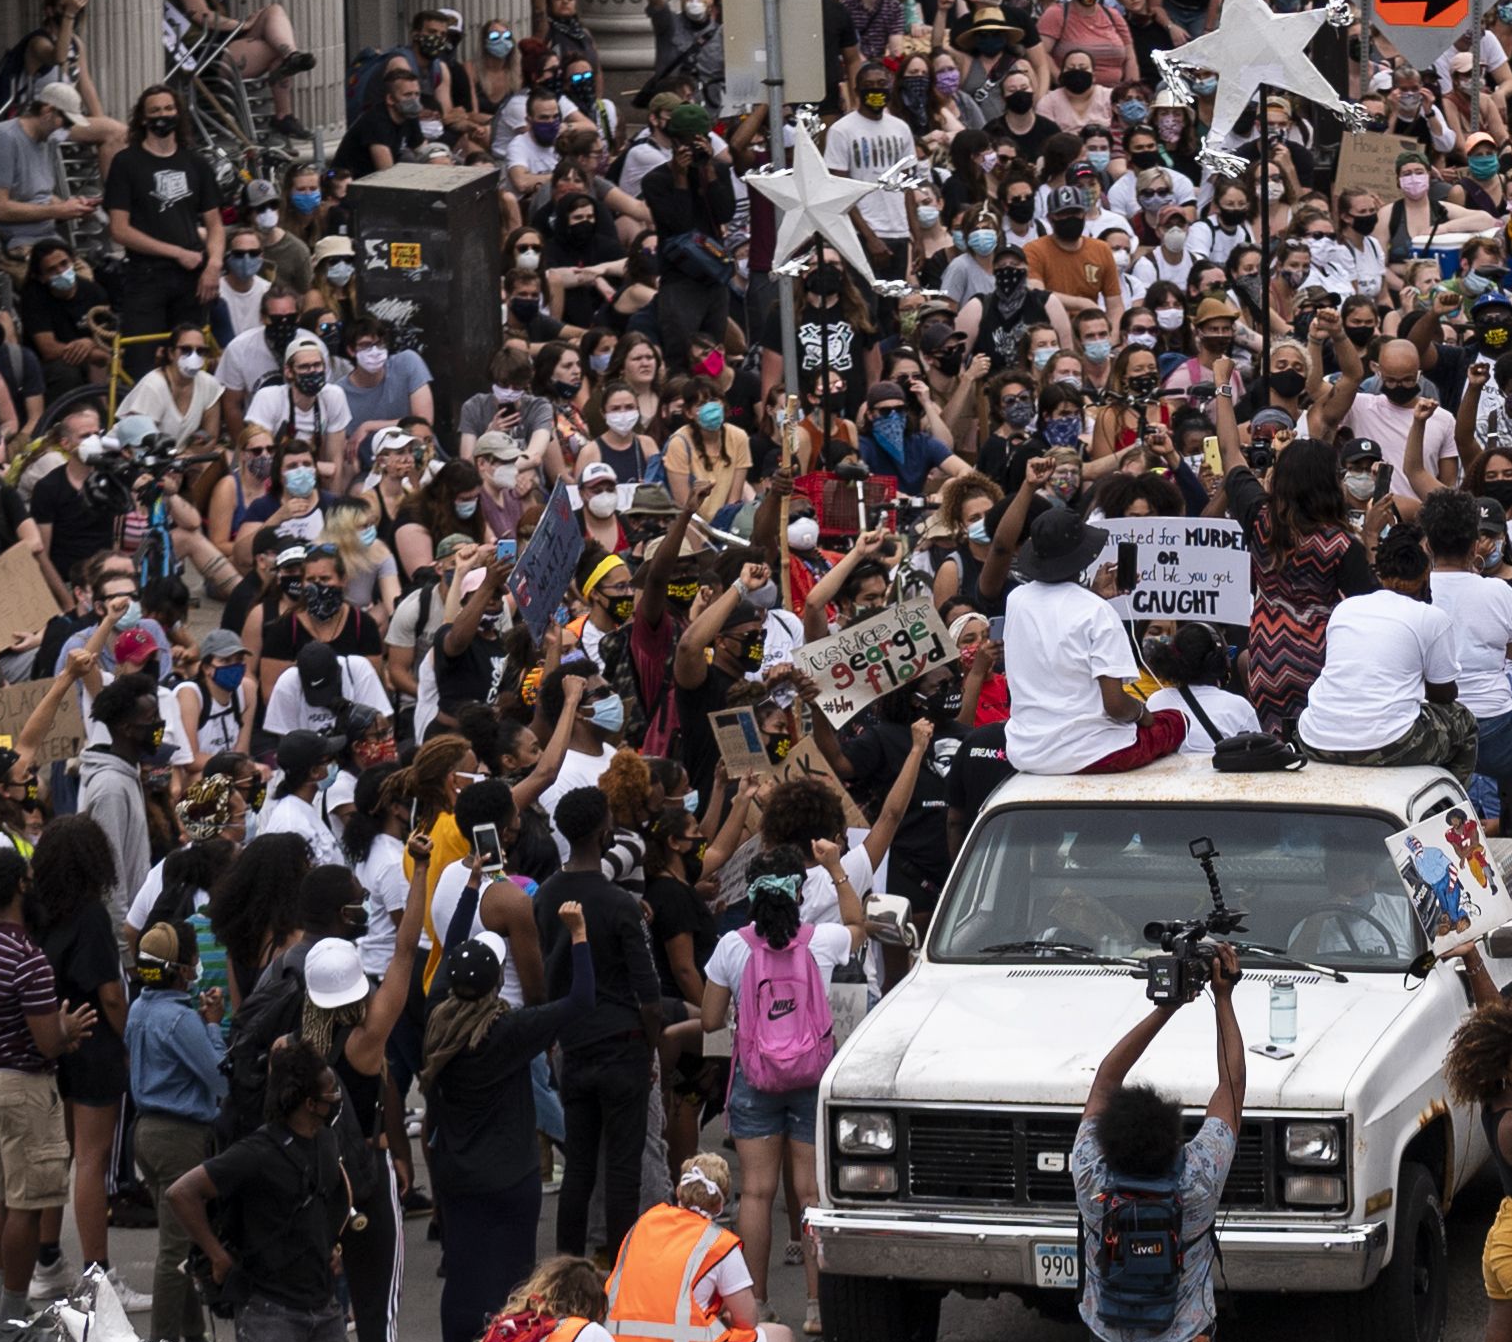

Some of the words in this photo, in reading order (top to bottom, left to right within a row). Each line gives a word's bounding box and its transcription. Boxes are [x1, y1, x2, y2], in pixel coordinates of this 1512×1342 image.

[1157, 528, 1181, 547] for
[1184, 528, 1249, 552] MURDER
[1157, 550, 1180, 566] OR
[1182, 572, 1207, 587] you
[1211, 569, 1235, 587] got
[1131, 588, 1221, 616] CAUGHT
[892, 603, 931, 630] for
[801, 621, 893, 676] justice
[830, 619, 928, 686] george
[864, 644, 946, 695] floyd
[822, 696, 855, 715] #blm
[771, 997, 797, 1012] NIKE
[1130, 1242, 1163, 1256] LiveU
[1041, 1254, 1075, 1277] 990
